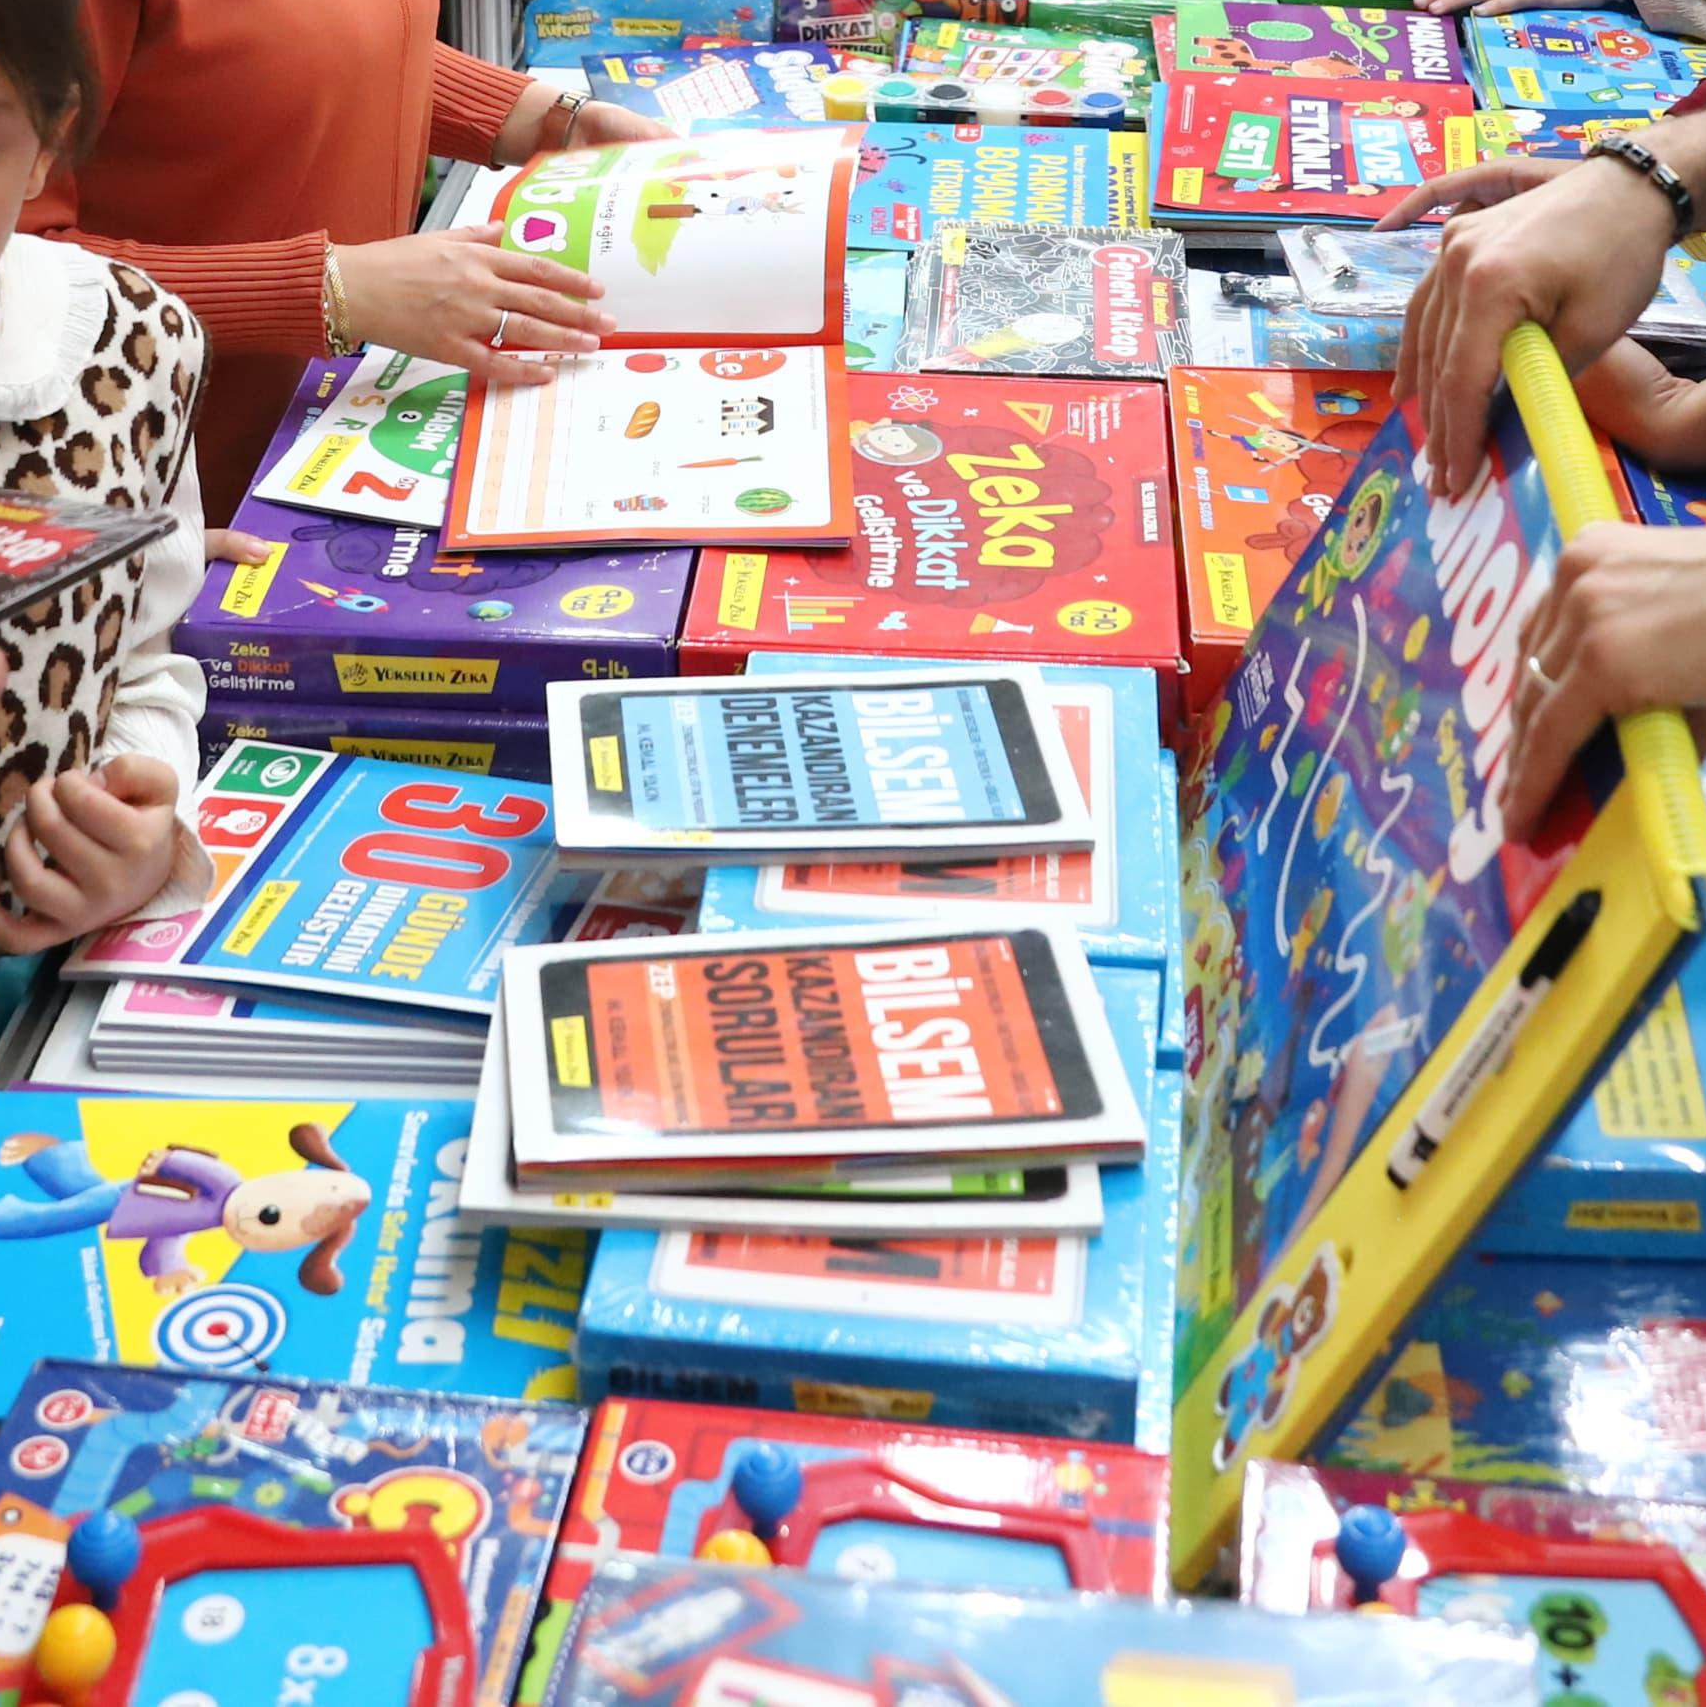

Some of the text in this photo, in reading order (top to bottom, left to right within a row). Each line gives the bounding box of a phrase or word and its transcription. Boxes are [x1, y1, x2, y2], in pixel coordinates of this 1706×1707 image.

[802, 19, 872, 42] DİKKAT
[1405, 15, 1452, 81] MAKASLI
[1223, 122, 1273, 171] SETİ
[1290, 98, 1343, 192] ETKİNLİK
[1358, 124, 1405, 182] EVDE
[1406, 119, 1438, 156] YAZ-SİL
[930, 158, 970, 215] KİTABIM
[1025, 154, 1068, 224] PARMAK
[1107, 252, 1144, 309] Fenerli
[1102, 309, 1146, 357] Kitap
[409, 389, 466, 453] KİTABIM
[295, 473, 318, 492] ZEKA
[945, 442, 1074, 568] Zeka
[852, 494, 904, 589] Geliştirme
[892, 470, 971, 591] ve Dikkat
[605, 588, 626, 614] 9-14
[729, 604, 744, 624] ZEKA
[1092, 606, 1118, 631] 7-10
[1221, 602, 1240, 624] ZEKA
[210, 659, 291, 675] ve Dikkat
[228, 642, 271, 658] Zeka
[374, 664, 489, 685] YÜKSELEN ZEKA
[581, 658, 629, 680] 9-14
[208, 674, 295, 694] Geliştirme
[225, 723, 267, 739] Zeka
[444, 751, 484, 768] ZEKA
[792, 694, 860, 823] KAZANDIRAN
[849, 691, 966, 822] BİLSEM
[720, 697, 799, 824] DENEMELER
[338, 782, 549, 891] 30
[280, 878, 368, 967] GELİŞTİR
[320, 884, 409, 973] DİKKATİNİ
[369, 893, 469, 981] GÜNDE
[647, 963, 679, 1000] ZEP
[703, 959, 798, 1128] SORULAR
[785, 955, 867, 1121] KAZANDIRAN
[853, 947, 993, 1120] BİLSEM
[383, 1109, 429, 1209] Sınavlarda
[365, 1254, 396, 1306] Hata
[1543, 1599, 1594, 1651] 10
